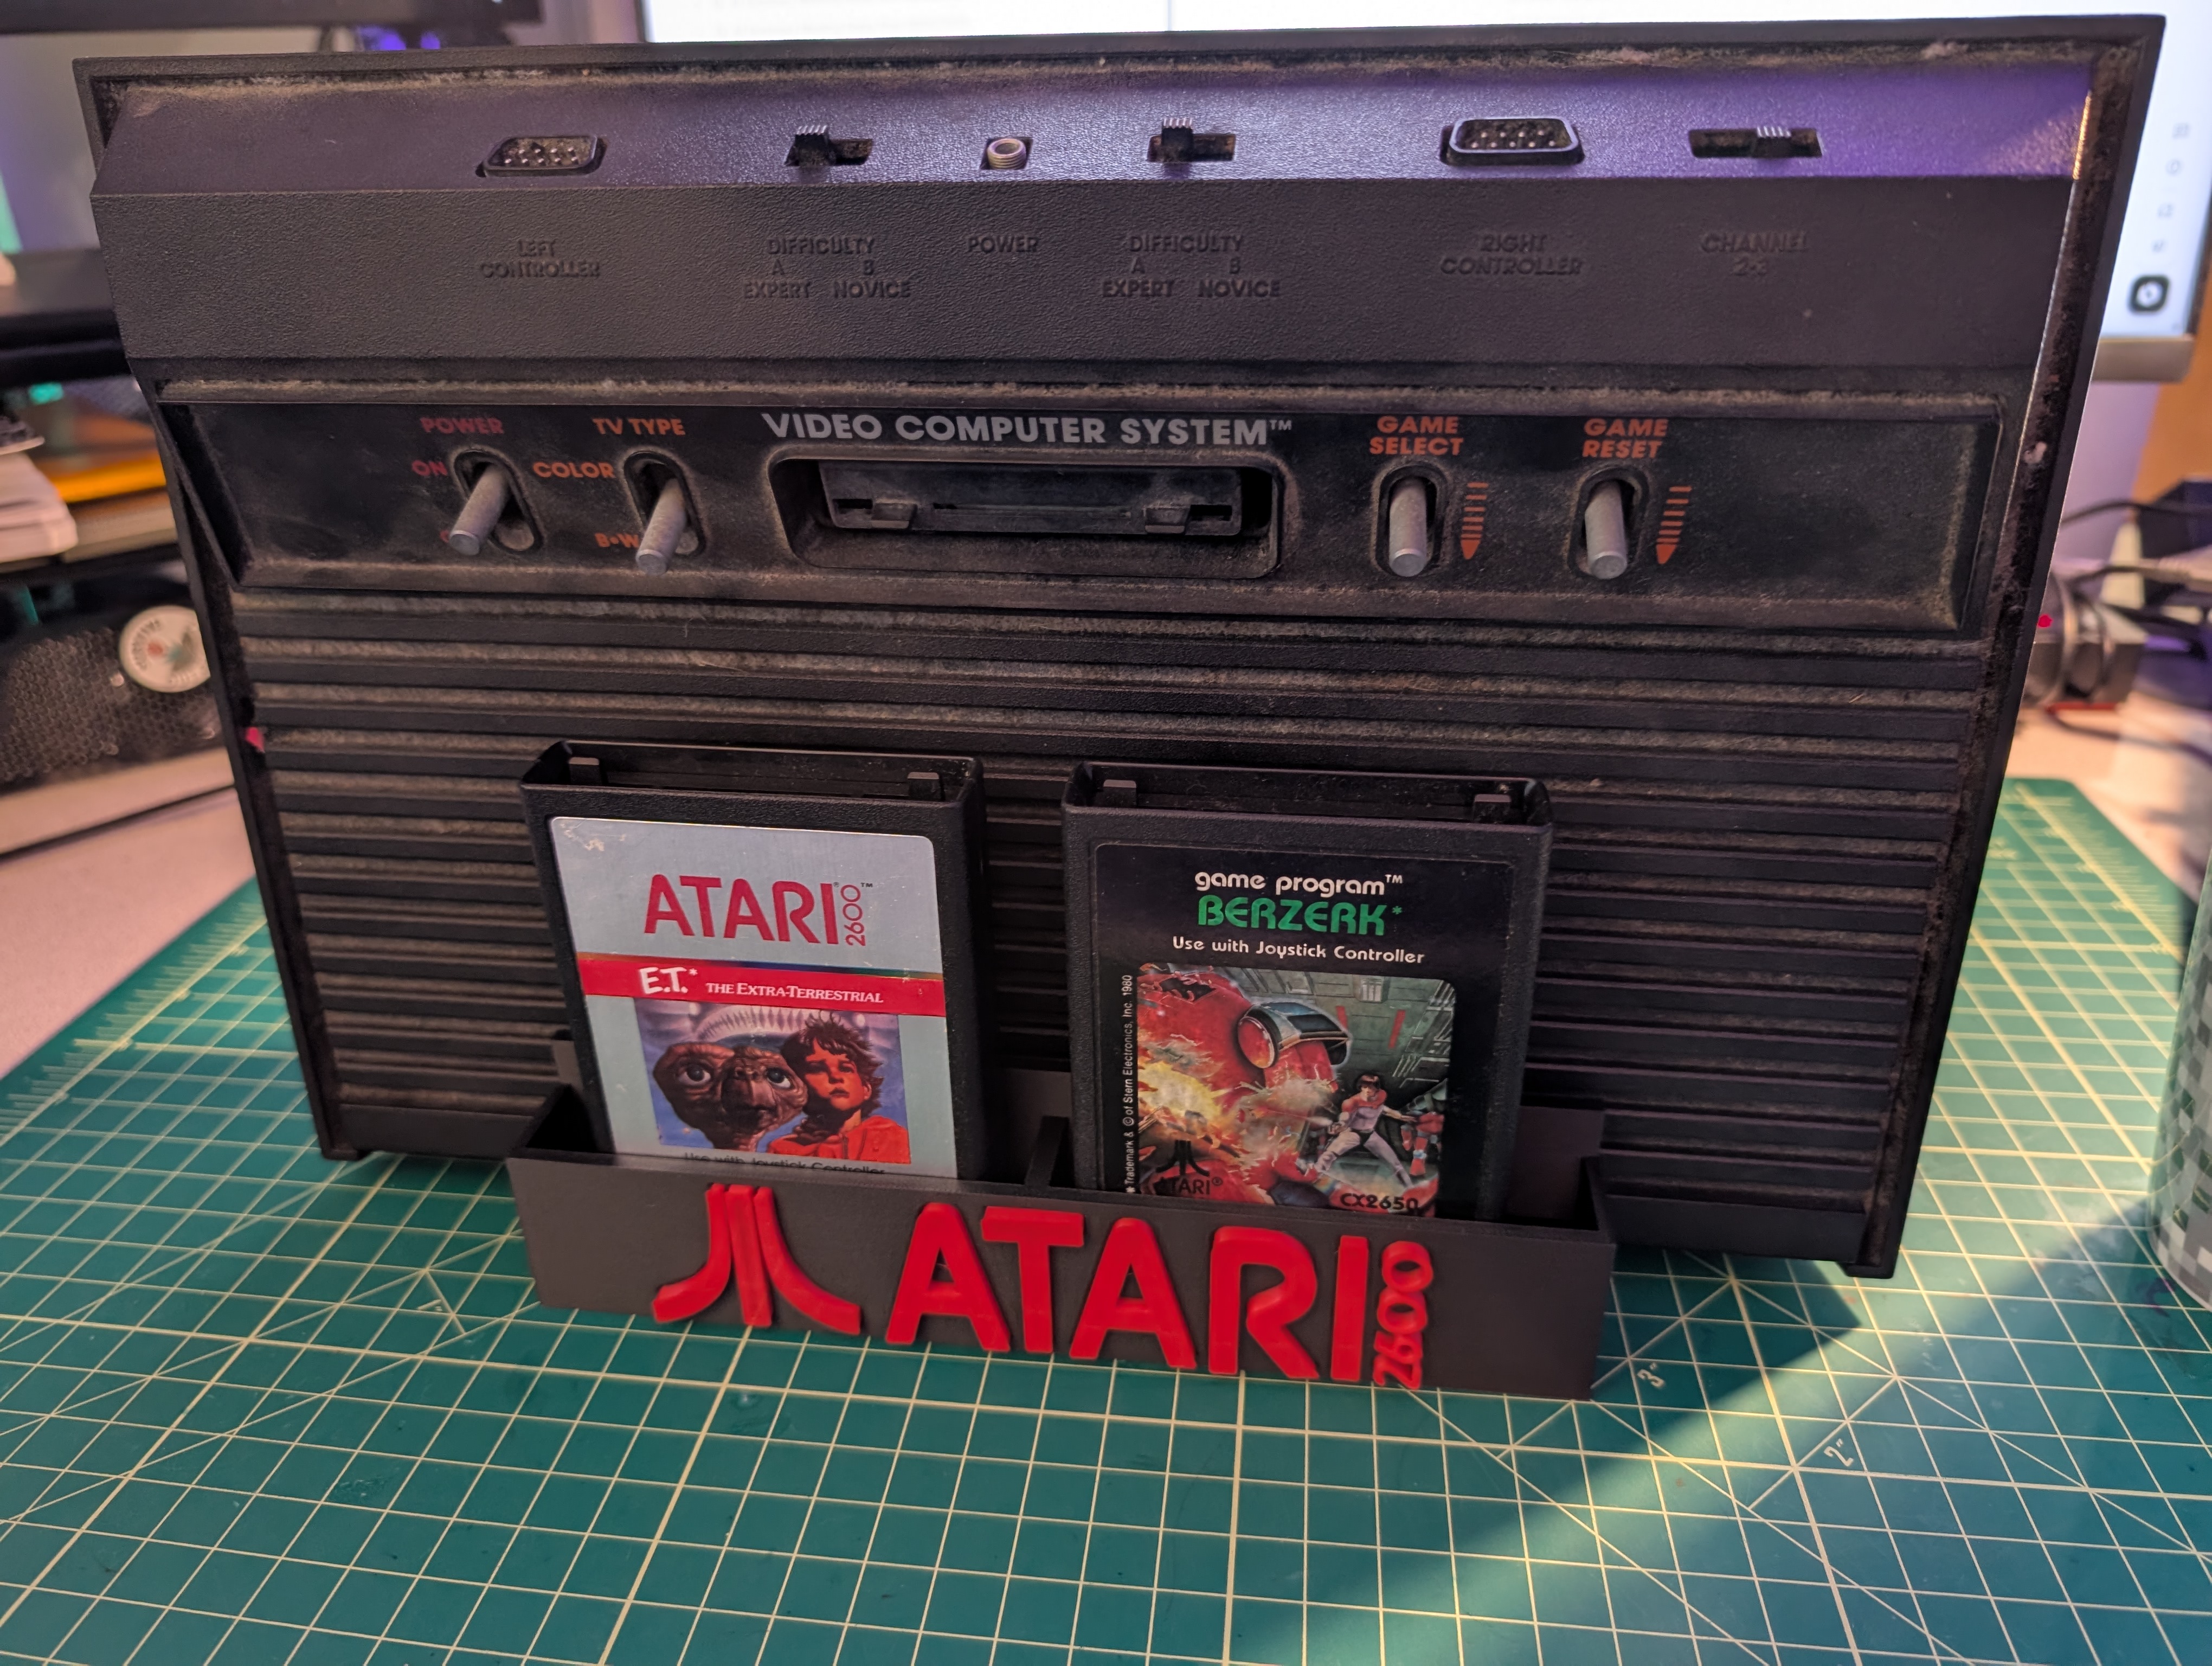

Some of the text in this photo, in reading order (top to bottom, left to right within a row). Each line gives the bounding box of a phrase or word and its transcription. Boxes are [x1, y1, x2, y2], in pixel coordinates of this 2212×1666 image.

[518, 239, 557, 257] LEFT
[767, 236, 875, 255] DIFFICULTY
[968, 235, 1039, 253] POWER
[1129, 235, 1243, 253] DIFFICULTY
[1700, 230, 1809, 253] CHANNEL
[480, 260, 601, 278] CONTROLLER
[772, 259, 875, 275] A B
[1130, 257, 1241, 274] A B
[1440, 257, 1584, 275] CONTROLLER
[744, 280, 911, 298] EXPERT NOVICE
[1102, 279, 1280, 298] EXPERT NOVICE
[420, 417, 505, 434] POWER
[593, 418, 686, 435] TV TYPE
[761, 413, 883, 440] VIDEO
[895, 415, 1106, 444] COMPUTER
[1377, 416, 1459, 434] GAME
[1584, 418, 1669, 437] GAME
[1369, 437, 1464, 456] SELECT
[1582, 440, 1663, 458] RESET
[411, 460, 448, 476] ON
[533, 462, 616, 479] COLOR
[1194, 872, 1266, 891] game
[840, 884, 866, 946] 2600
[1173, 935, 1425, 964] Use with Joystick Controller
[706, 982, 735, 994] THE
[1121, 975, 1134, 997] 1980
[1122, 1021, 1134, 1076] Electronics,
[1122, 1078, 1133, 1104] Stern
[885, 1201, 1434, 1391] ATARI 2600
[1823, 1438, 1854, 1467] 2"
